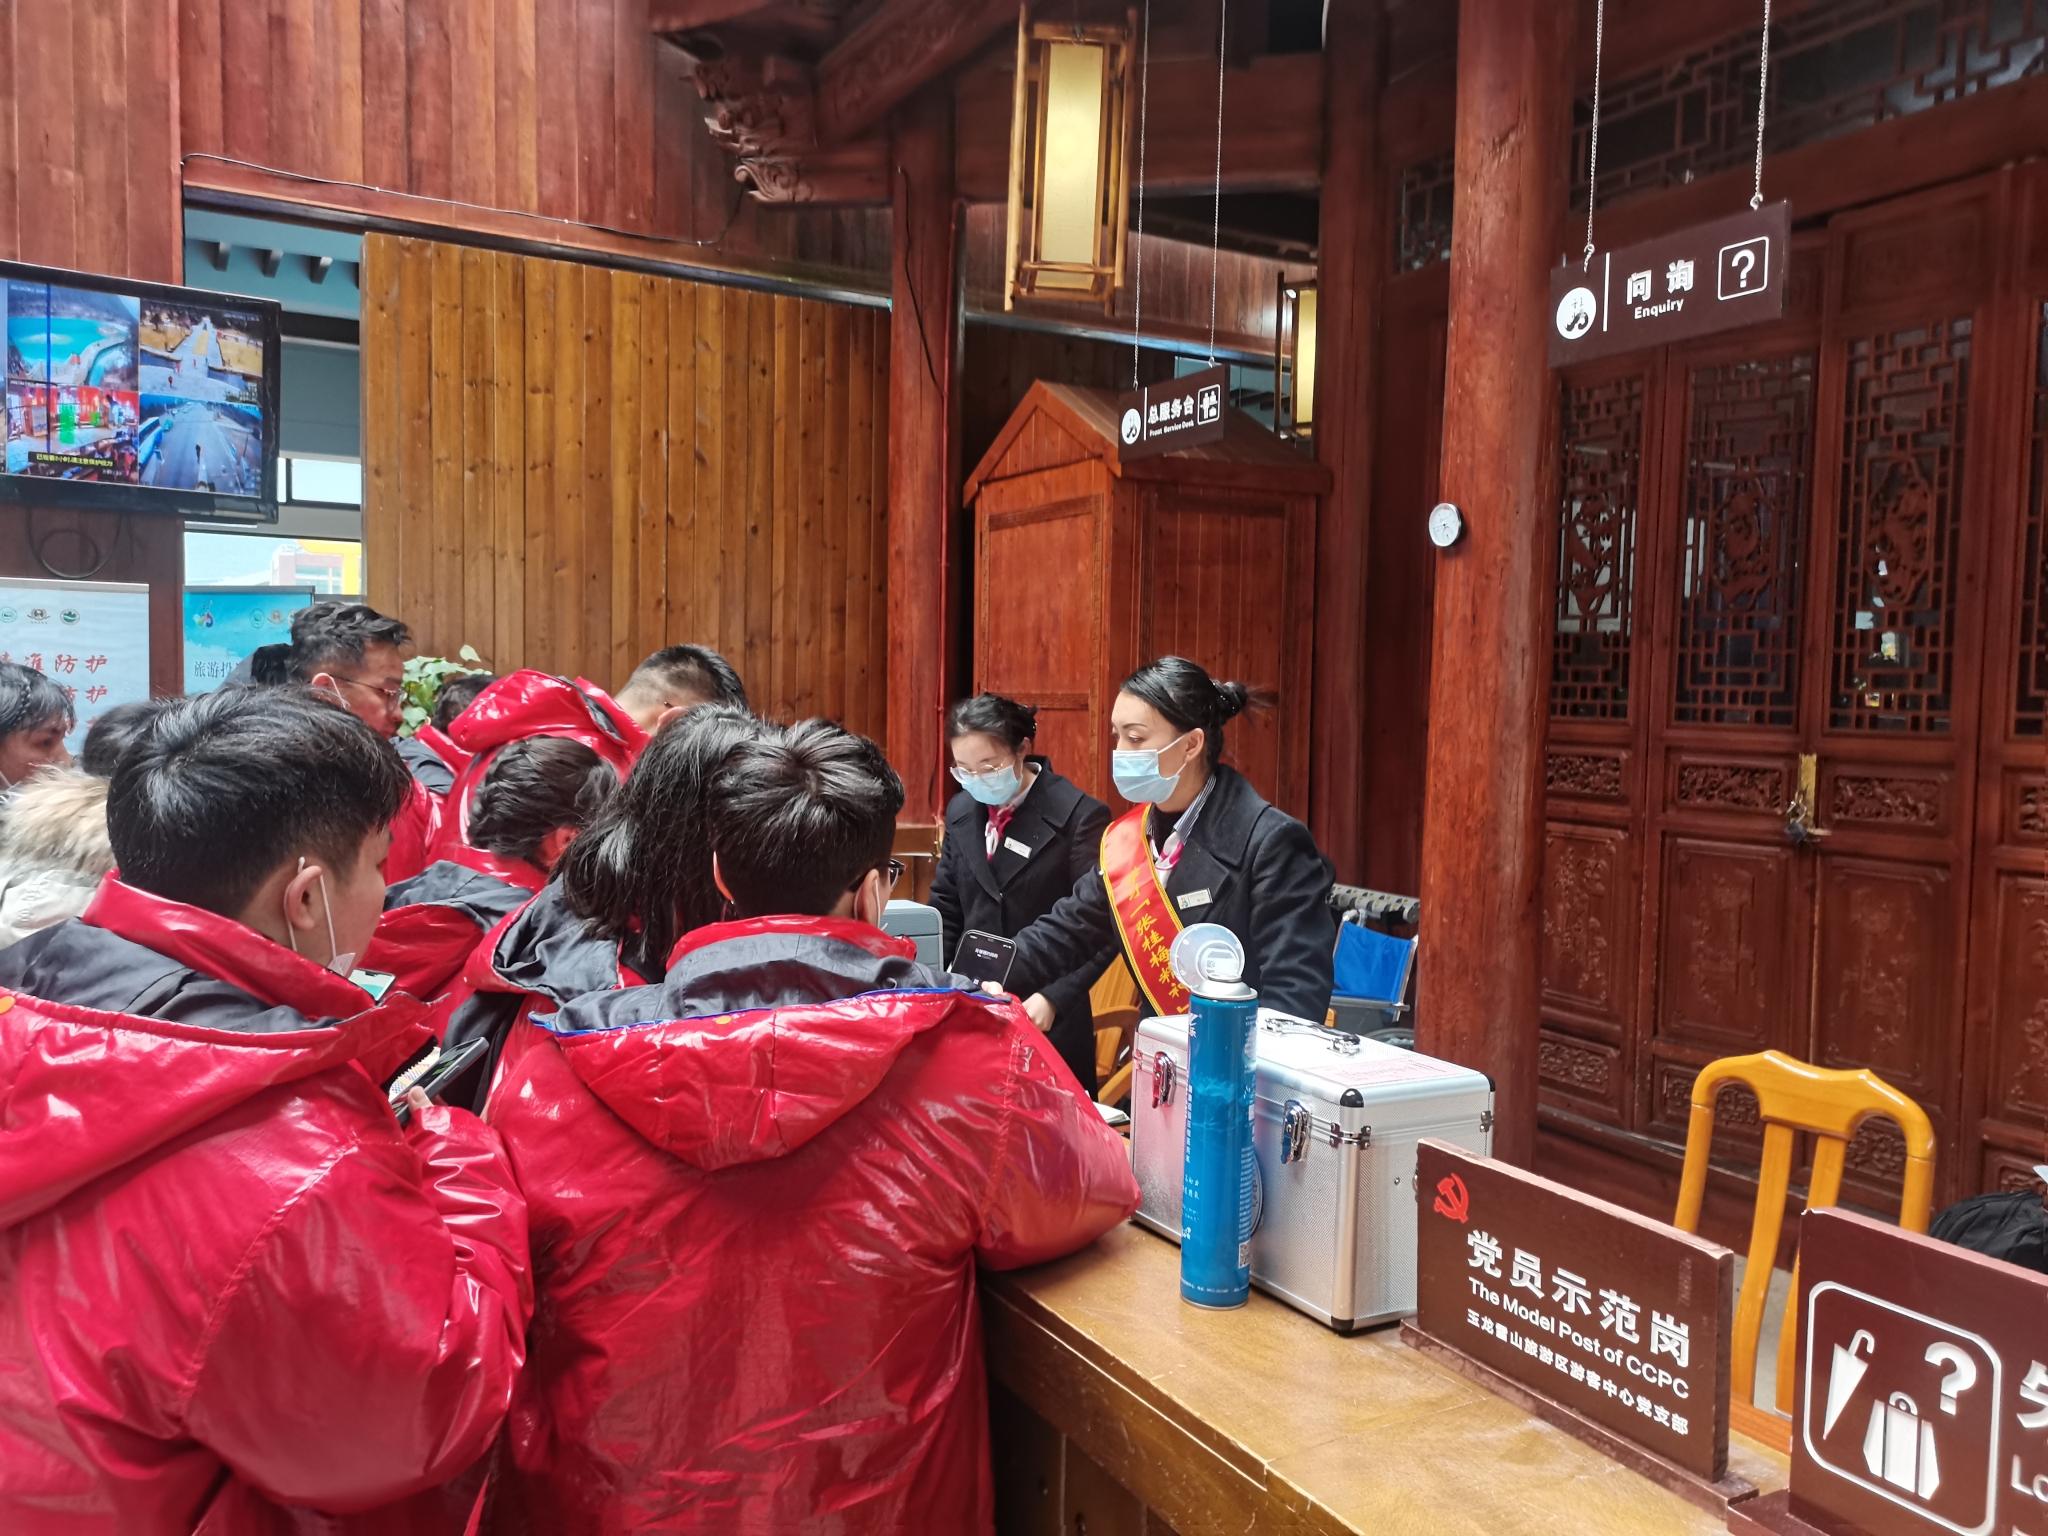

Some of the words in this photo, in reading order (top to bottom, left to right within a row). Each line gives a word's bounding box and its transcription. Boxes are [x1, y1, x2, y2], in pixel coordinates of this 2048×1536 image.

[1626, 260, 1694, 305] 问询
[1634, 298, 1684, 319] Enquiry
[1147, 394, 1194, 424] 总服务台
[1163, 423, 1181, 433] Service
[194, 661, 241, 678] 旅游投
[1467, 1229, 1689, 1368] 党员示范岗
[1468, 1276, 1500, 1306] The
[1503, 1293, 1555, 1334] Model
[1558, 1320, 1601, 1357] Post
[1603, 1347, 1624, 1367] of
[1626, 1355, 1689, 1399] CCPC
[1467, 1308, 1689, 1435] 玉龙雪山旅游区游客中心党支部
